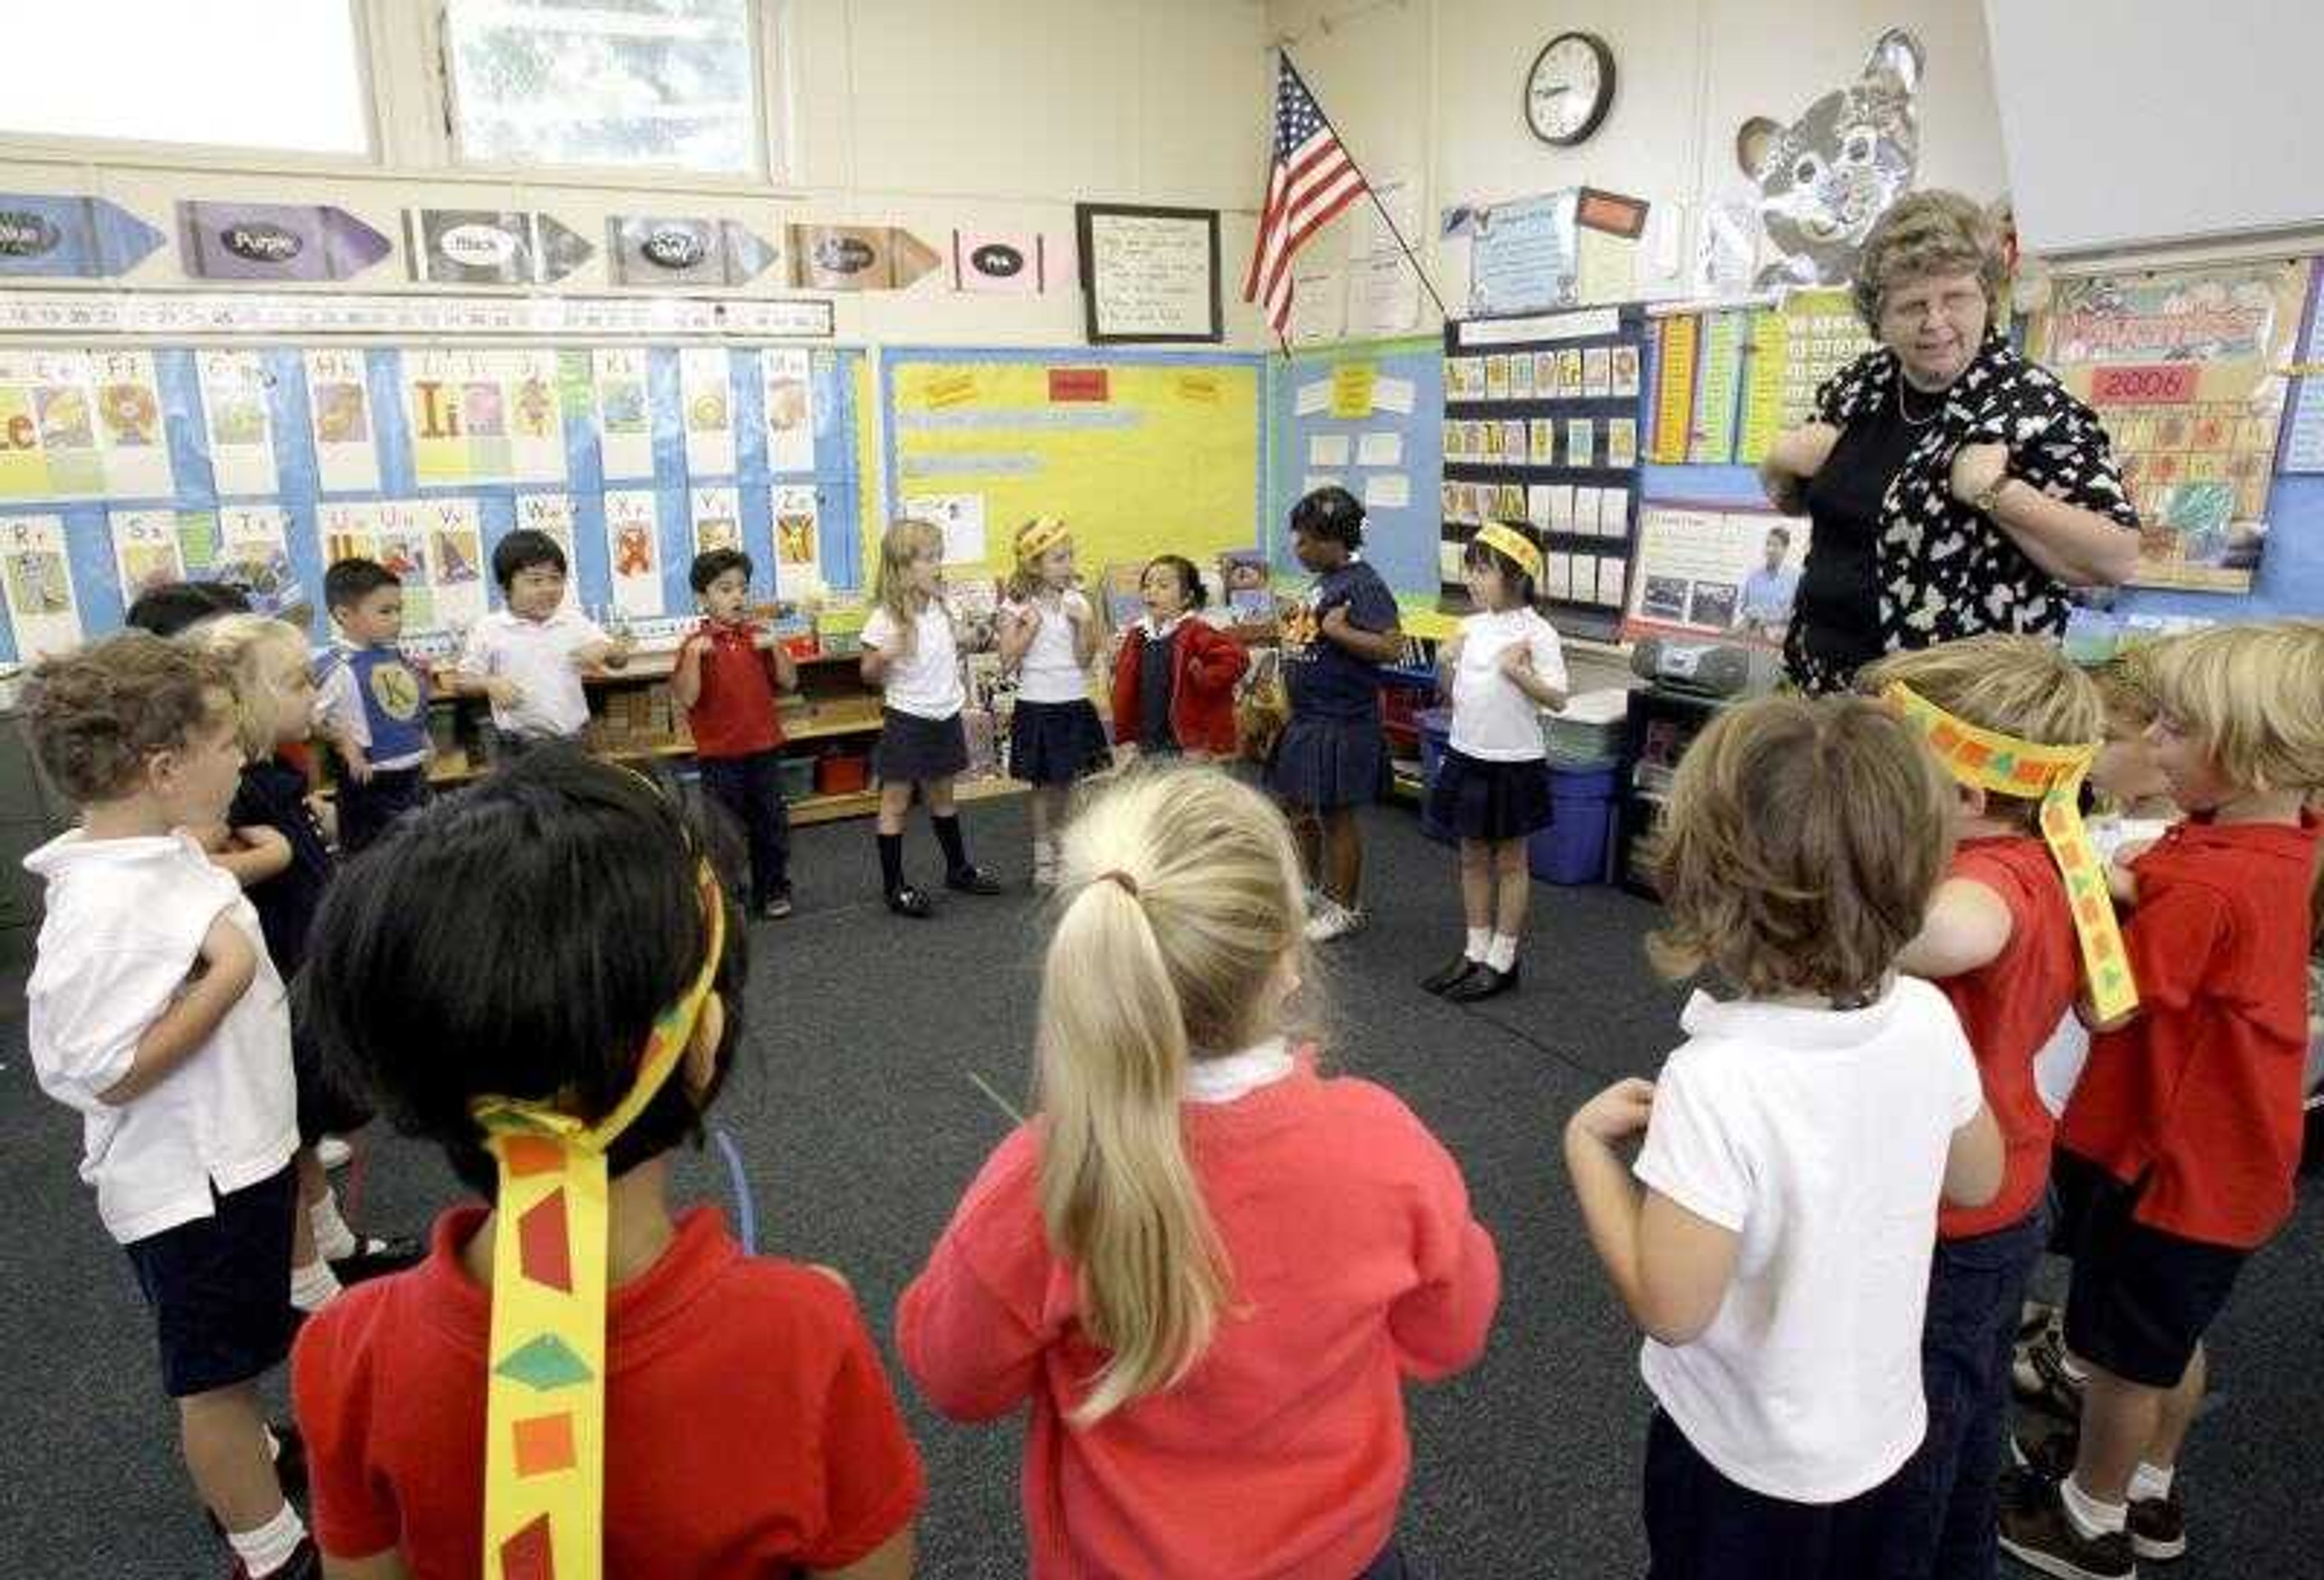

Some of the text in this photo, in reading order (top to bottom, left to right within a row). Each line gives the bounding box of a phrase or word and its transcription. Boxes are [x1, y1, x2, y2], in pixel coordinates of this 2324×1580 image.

[234, 231, 299, 254] Purple
[2104, 370, 2183, 396] 2006
[379, 672, 413, 706] K
